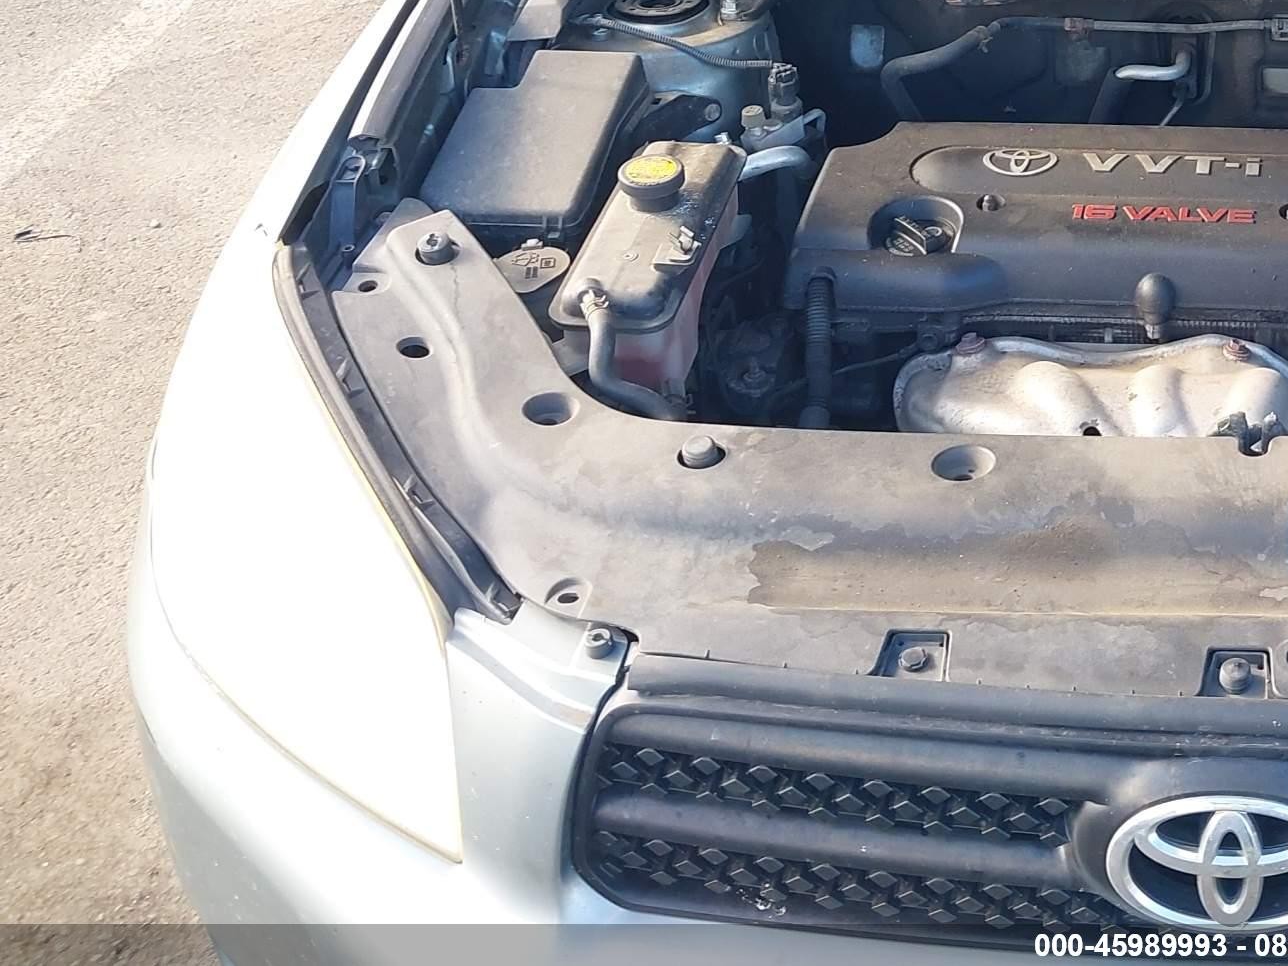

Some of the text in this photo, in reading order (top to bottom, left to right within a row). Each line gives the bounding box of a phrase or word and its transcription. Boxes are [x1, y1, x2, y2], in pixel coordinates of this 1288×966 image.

[1082, 152, 1263, 177] VVT-i
[1071, 202, 1257, 224] 16 VALVE
